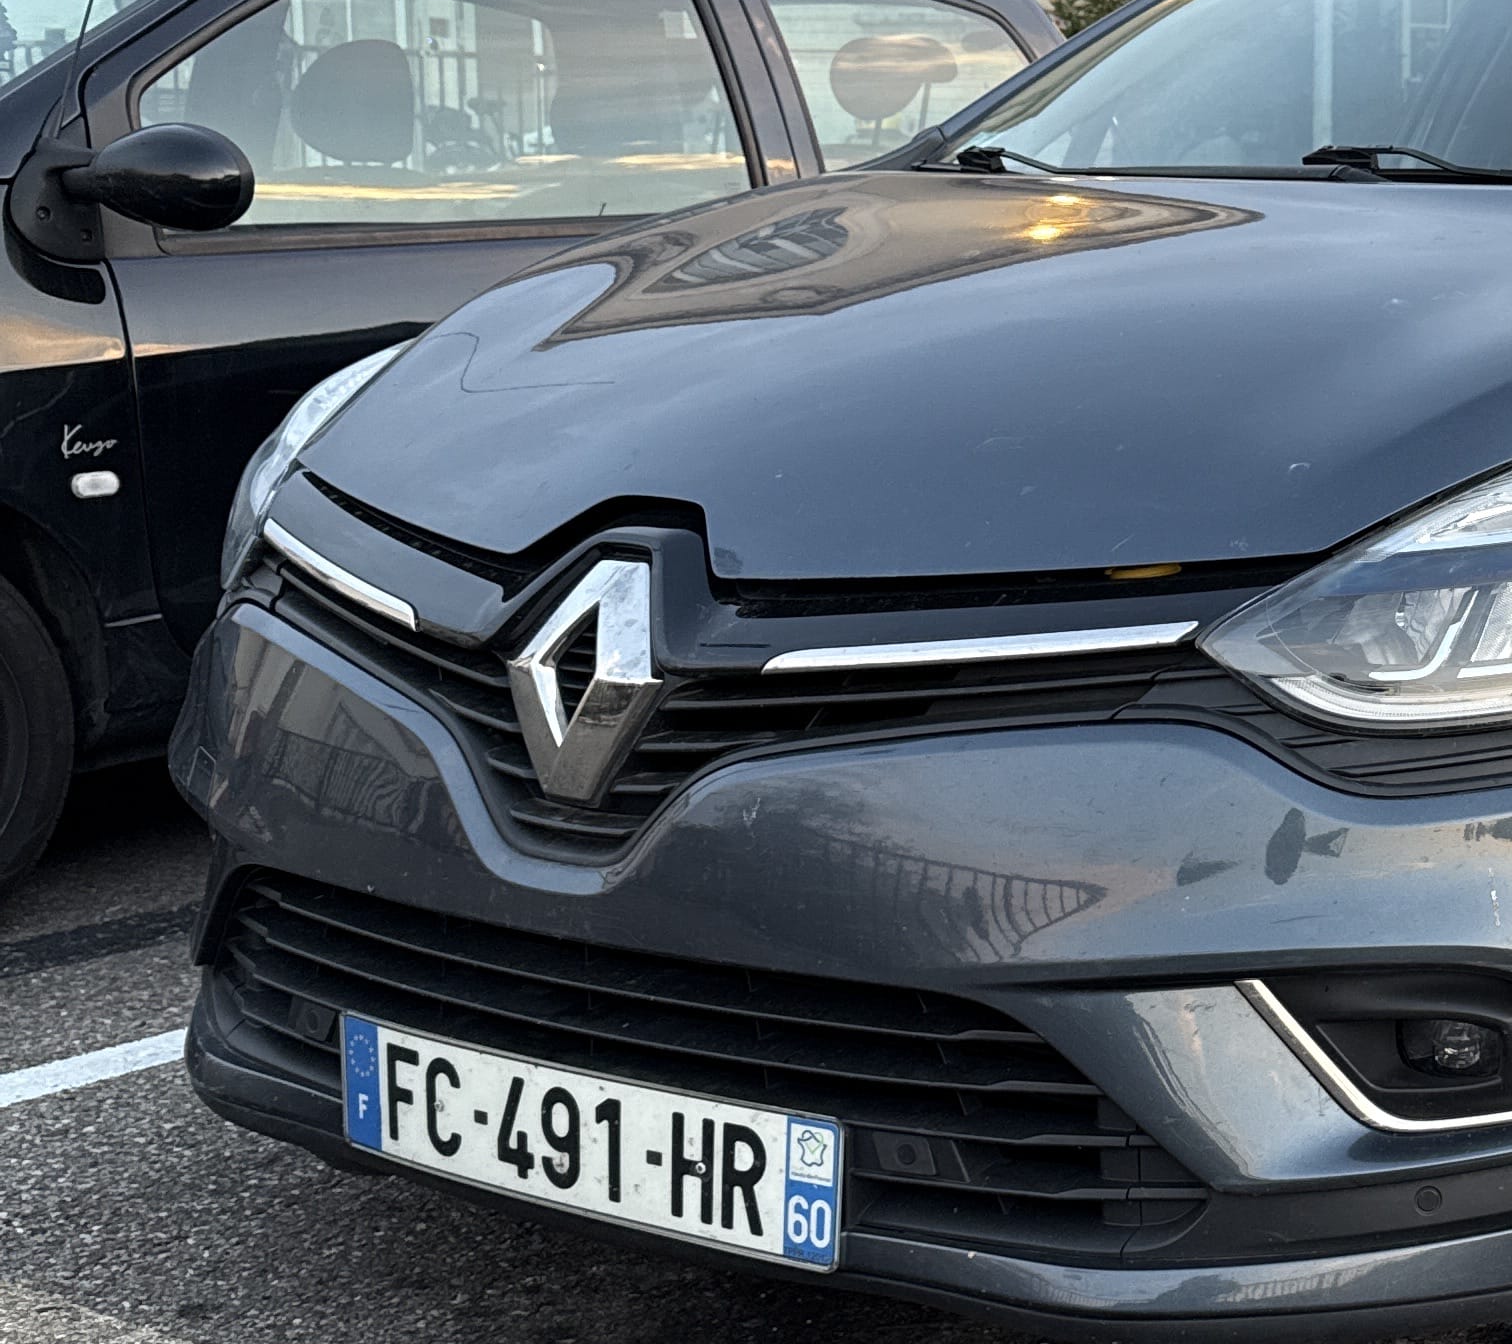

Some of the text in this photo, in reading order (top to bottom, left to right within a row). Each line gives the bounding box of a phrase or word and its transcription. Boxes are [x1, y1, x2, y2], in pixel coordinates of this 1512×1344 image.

[358, 1093, 369, 1120] F
[386, 1042, 767, 1236] FC-491-HR
[787, 1194, 832, 1248] 60
